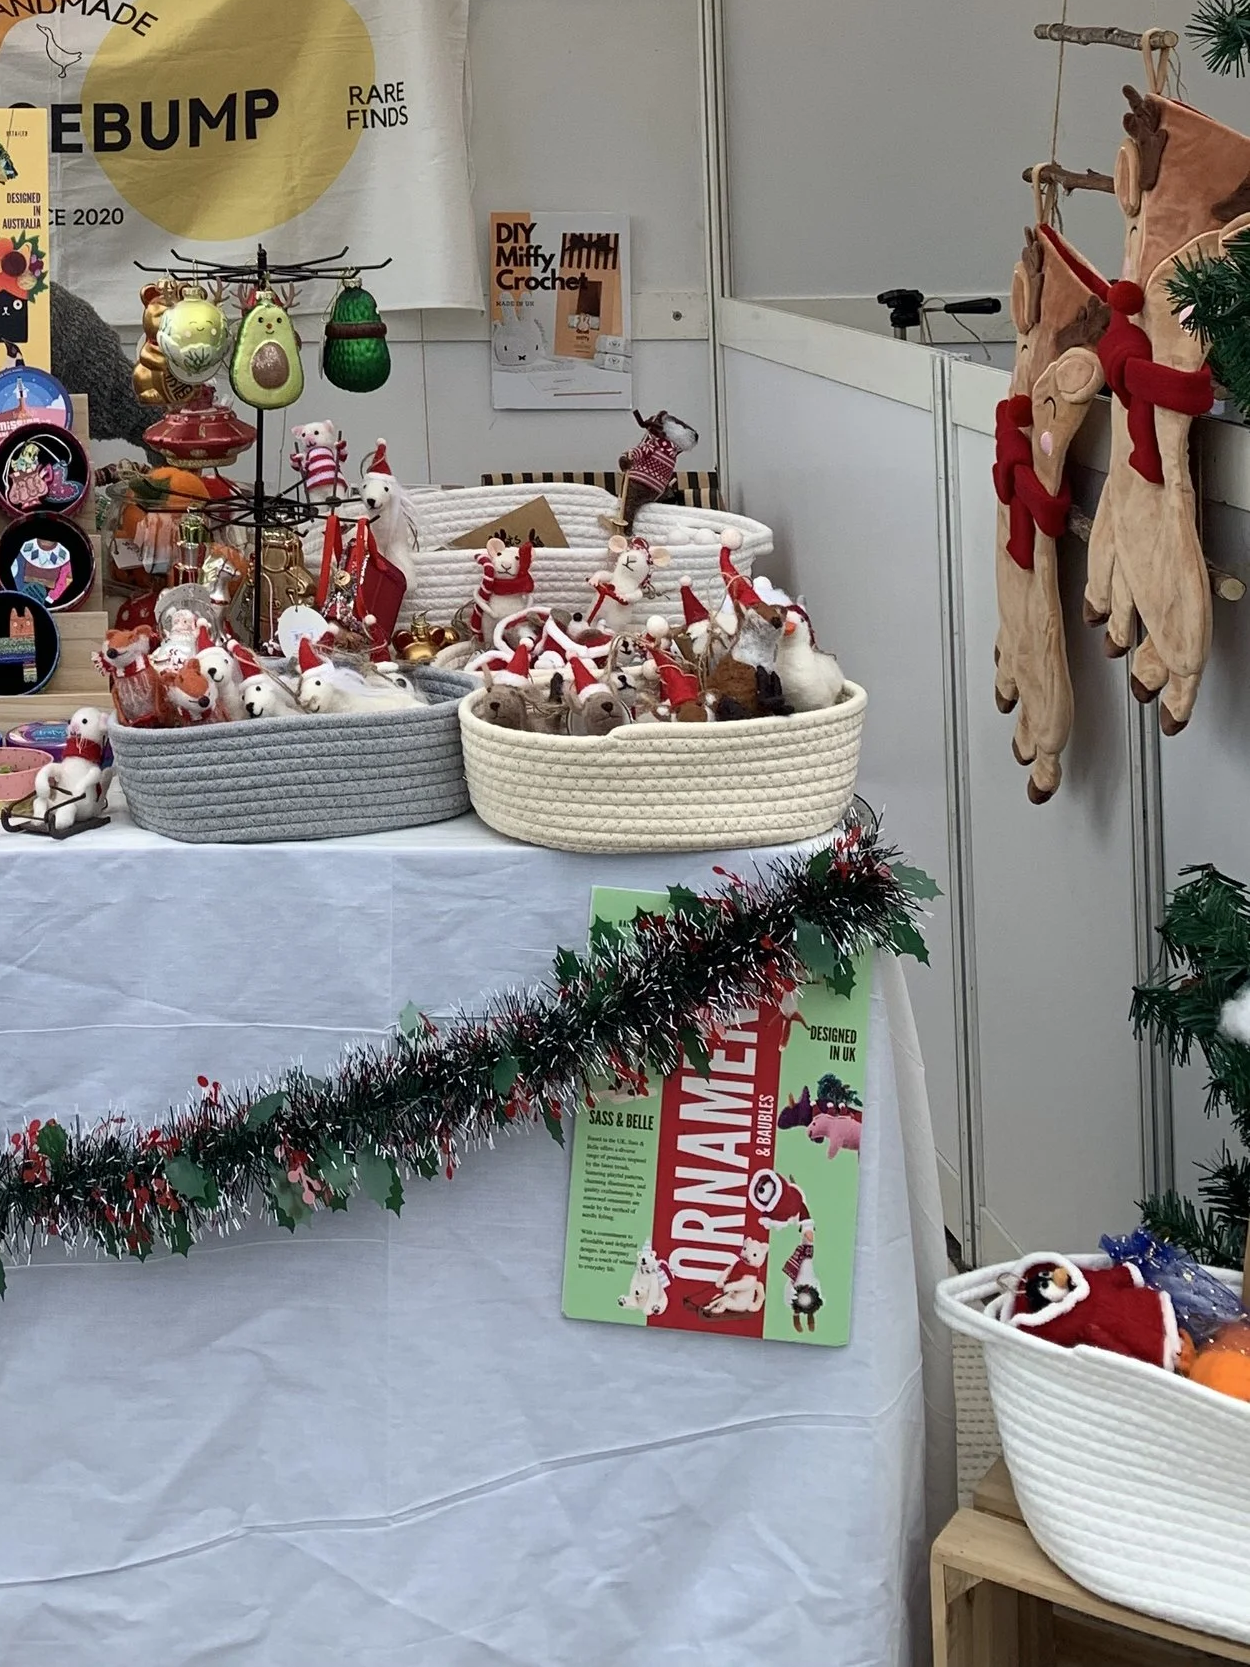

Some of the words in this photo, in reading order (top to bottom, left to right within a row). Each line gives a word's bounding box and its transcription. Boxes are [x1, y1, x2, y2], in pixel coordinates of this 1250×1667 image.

[348, 81, 405, 106] RARE
[346, 106, 409, 130] FINDS
[6, 192, 41, 204] DESIGNED
[33, 205, 41, 216] IN
[73, 207, 125, 228] 2020
[2, 218, 41, 230] AUSTRALIA
[496, 222, 537, 244] DIY
[496, 245, 556, 273] Miffy
[496, 268, 589, 291] Crochet
[809, 1025, 857, 1044] DESIGNED
[829, 1045, 840, 1061] IN
[842, 1046, 856, 1062] UK
[589, 1110, 614, 1127] SASS
[615, 1113, 624, 1127] &
[626, 1114, 655, 1131] BELLE
[756, 1094, 775, 1145] BAUBLES
[755, 1146, 771, 1157] &
